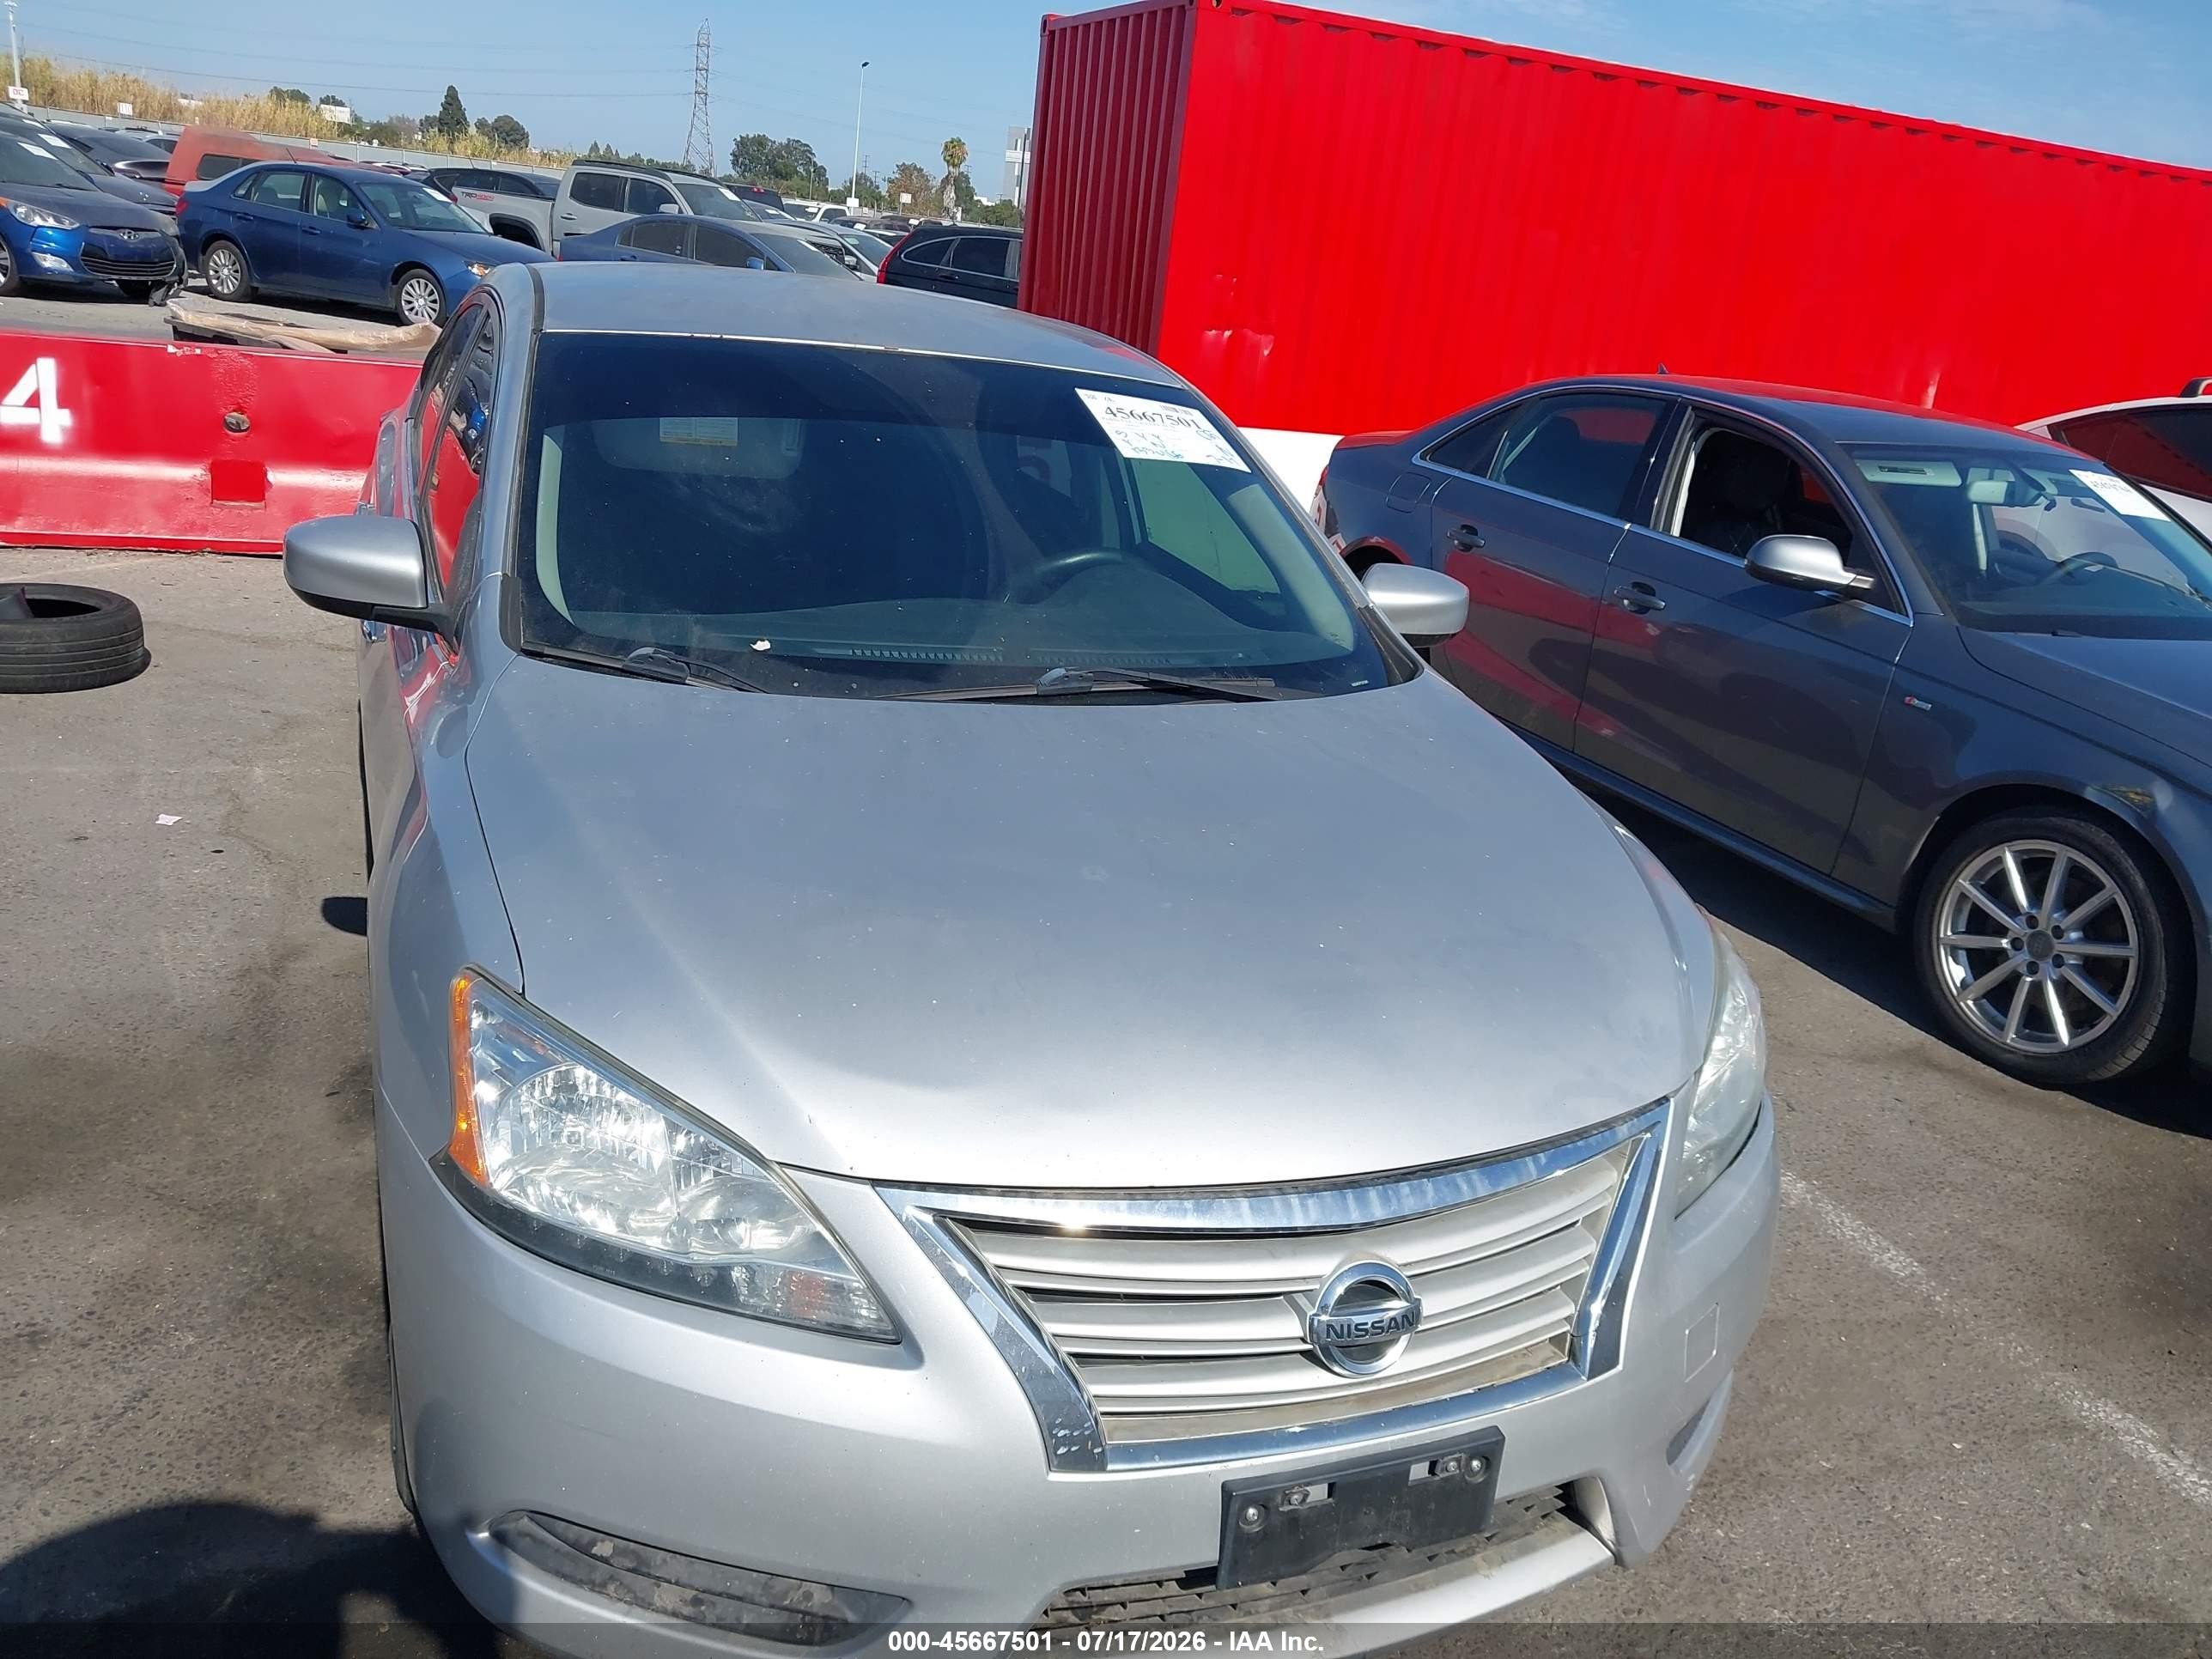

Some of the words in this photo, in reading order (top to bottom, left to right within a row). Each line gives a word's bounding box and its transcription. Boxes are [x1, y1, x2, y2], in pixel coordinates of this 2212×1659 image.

[0, 356, 72, 444] 4
[1105, 406, 1202, 429] 45667501
[1325, 1310, 1416, 1341] NISSAN
